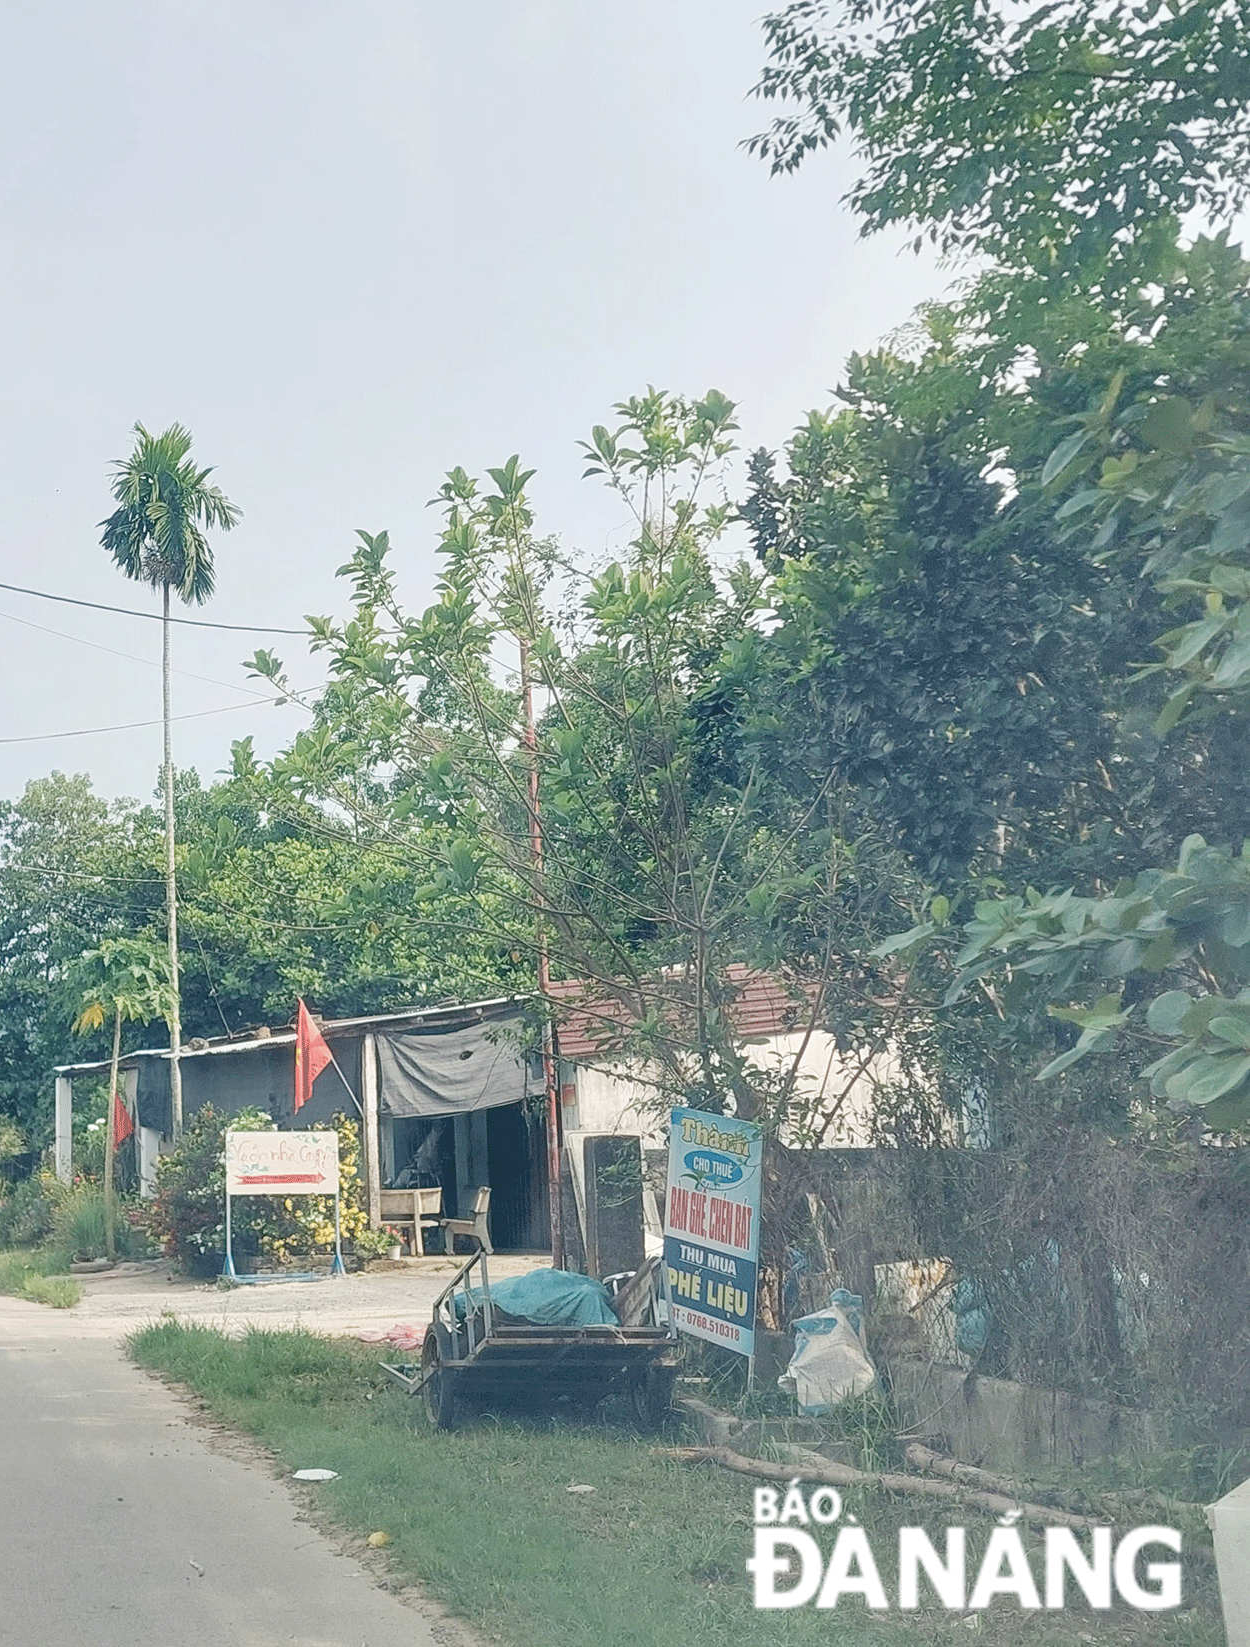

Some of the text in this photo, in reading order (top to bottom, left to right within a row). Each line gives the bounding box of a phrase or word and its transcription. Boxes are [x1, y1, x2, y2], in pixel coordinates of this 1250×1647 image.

[693, 1156, 733, 1179] CHO THUÊ
[669, 1180, 689, 1231] BÀN
[709, 1192, 734, 1246] CHÉN
[734, 1198, 752, 1250] BÁT
[679, 1244, 737, 1276] THU MUA
[667, 1267, 749, 1319] PHẾ LIỆU
[687, 1313, 740, 1341] 0768.510318
